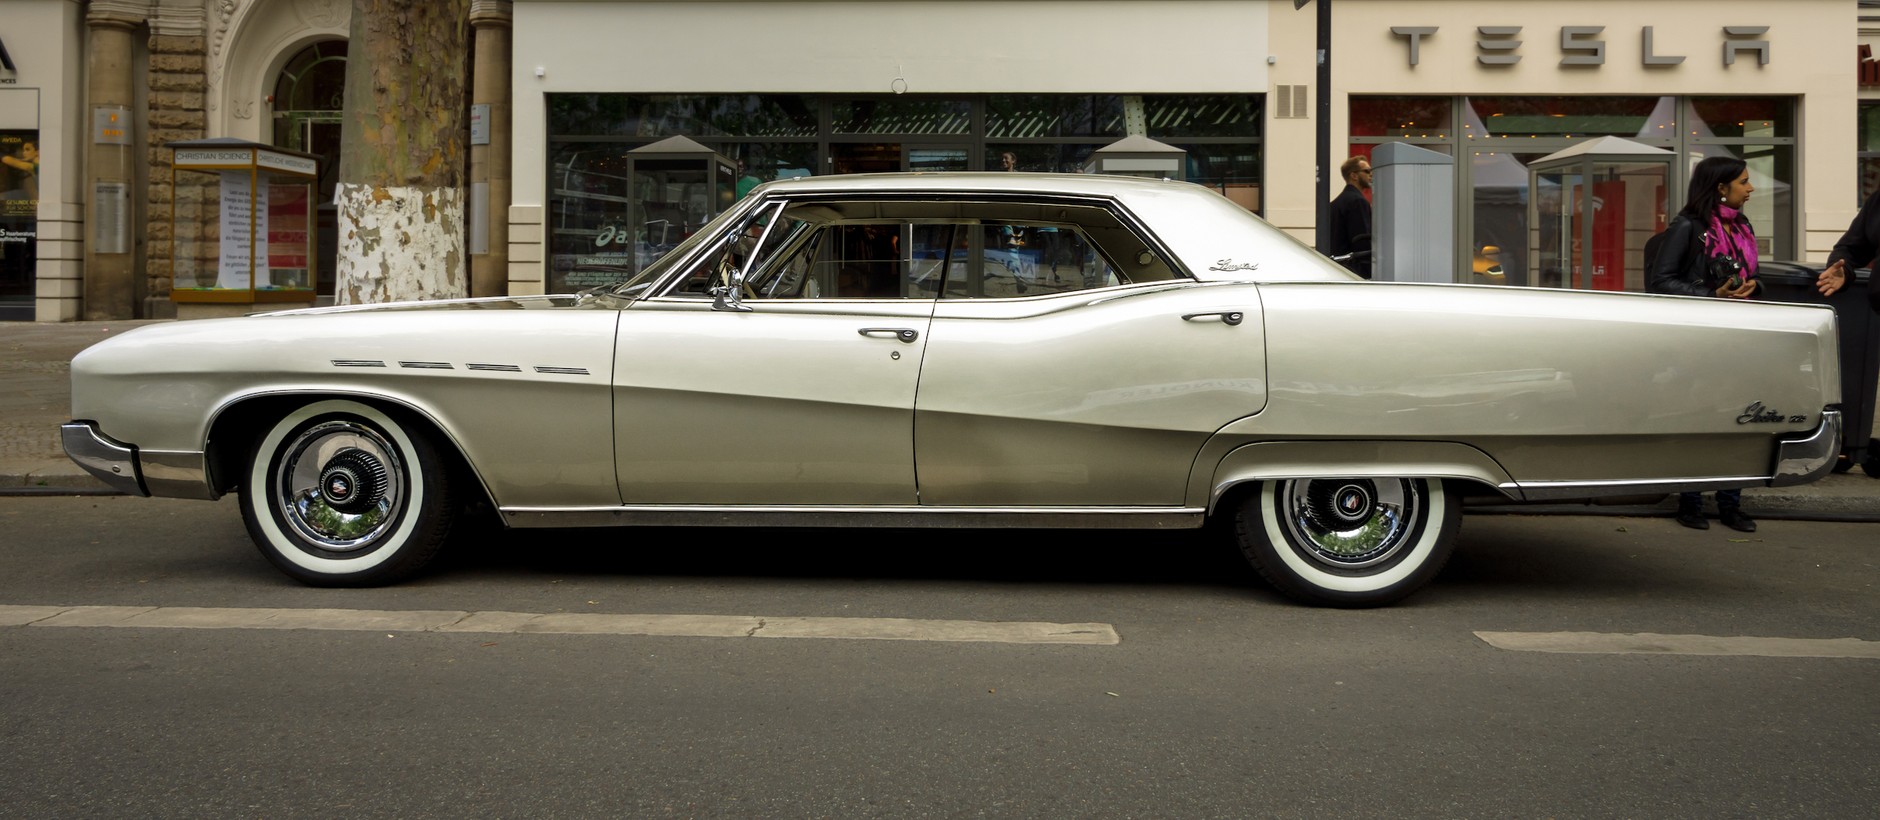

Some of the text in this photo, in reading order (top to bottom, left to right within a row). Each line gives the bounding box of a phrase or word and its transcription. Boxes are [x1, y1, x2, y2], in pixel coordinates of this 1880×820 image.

[1390, 26, 1770, 66] TESLA
[176, 152, 252, 160] CHRISTIAN SCIENCE
[1209, 258, 1259, 272] Limited
[1575, 266, 1604, 275] TLA
[1737, 400, 1785, 424] Electra
